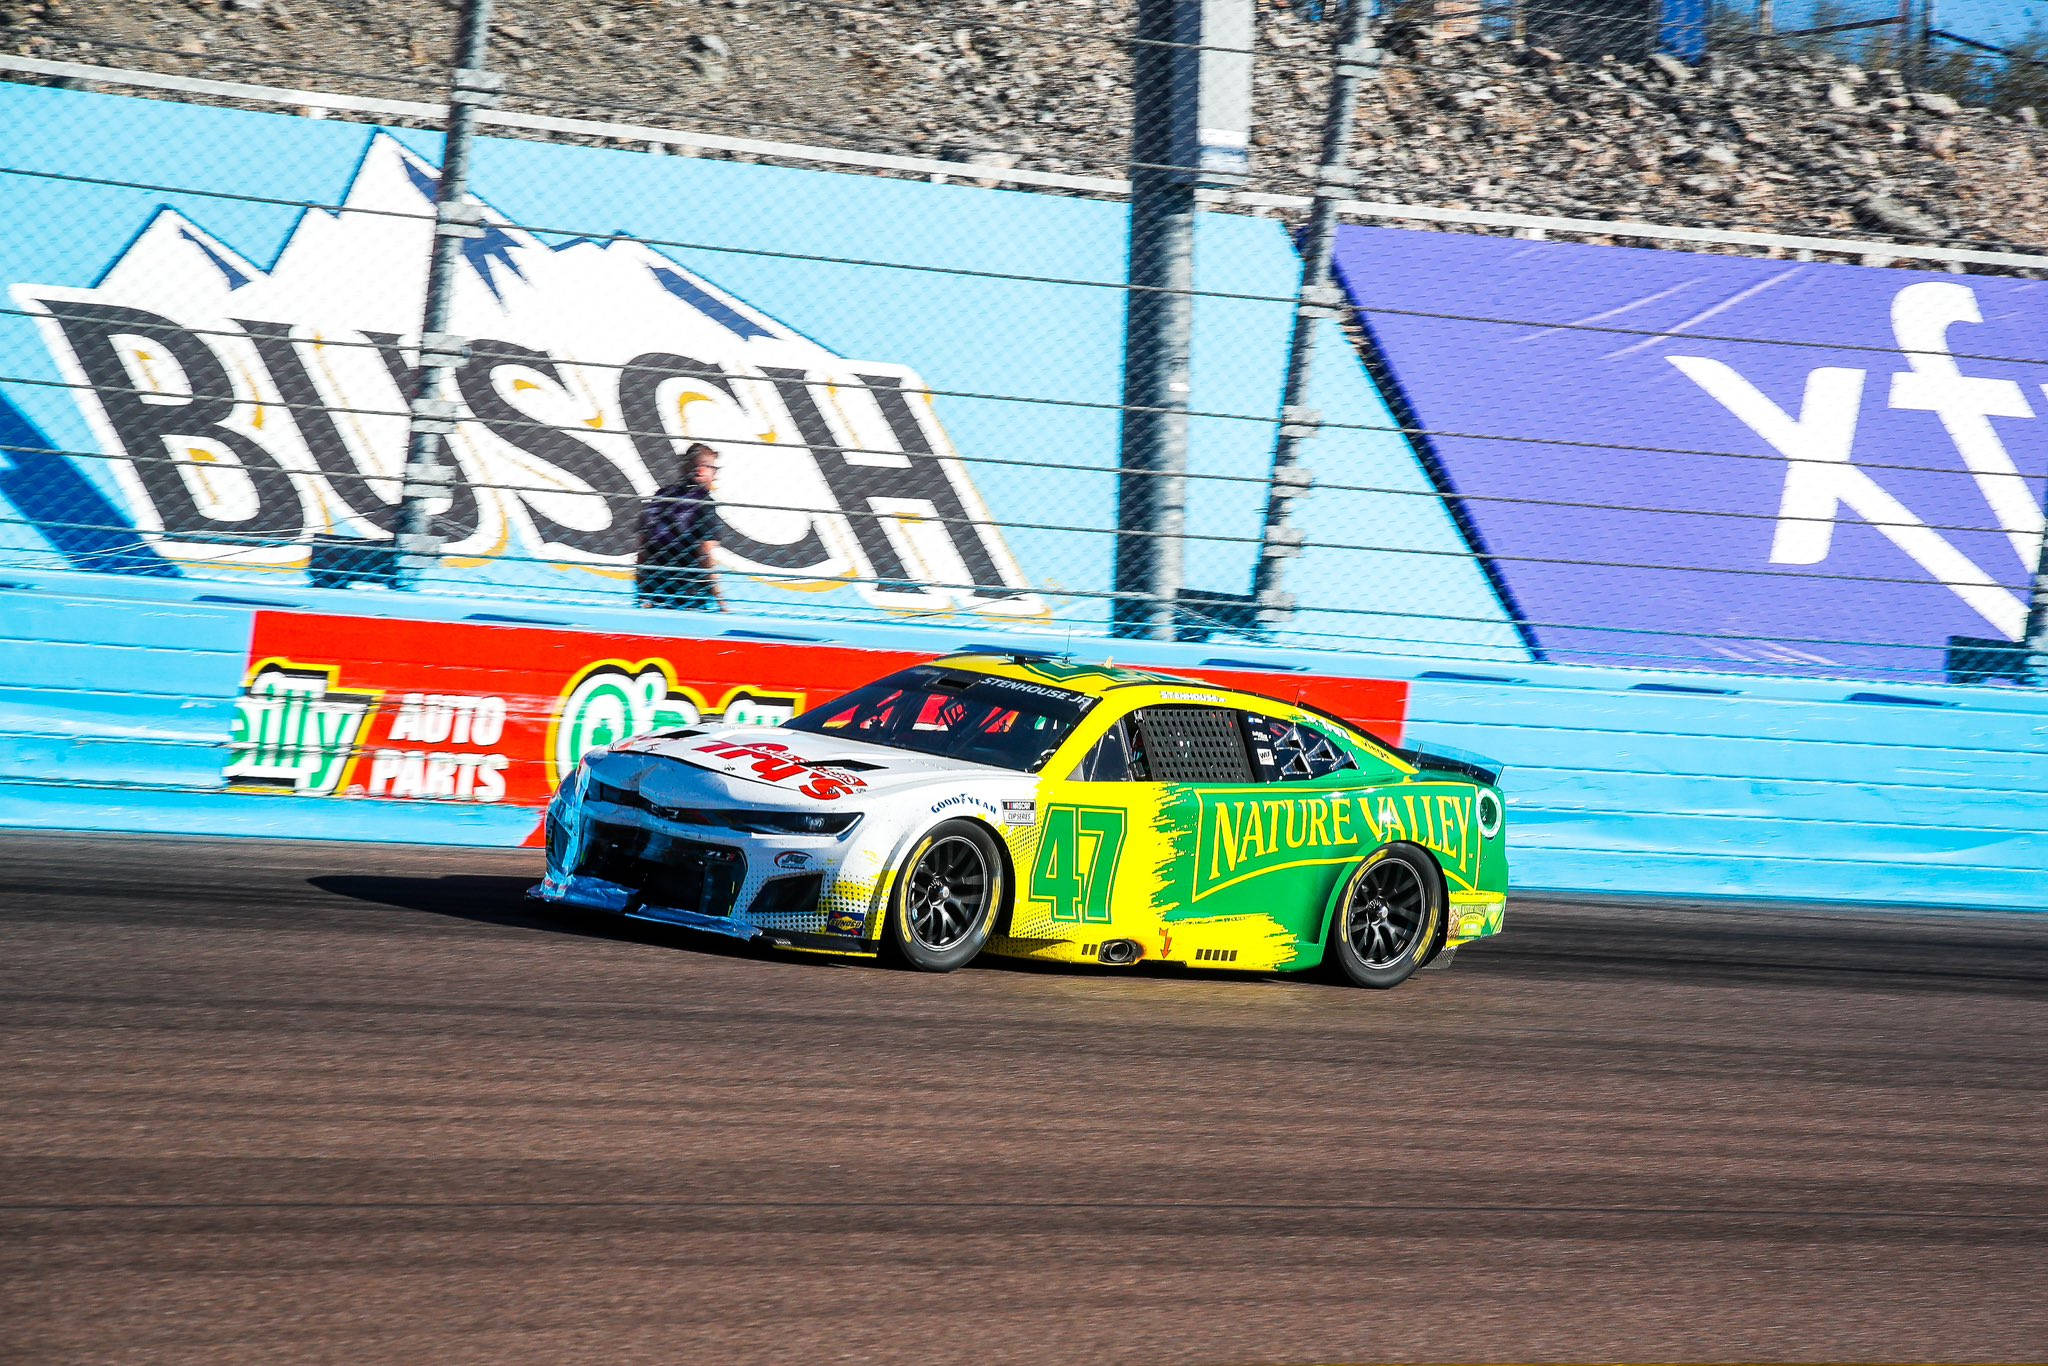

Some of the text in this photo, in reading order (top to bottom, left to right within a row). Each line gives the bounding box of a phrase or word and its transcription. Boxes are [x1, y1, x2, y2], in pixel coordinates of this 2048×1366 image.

[31, 298, 1028, 601] BUSCH
[1665, 281, 2048, 643] xf
[980, 676, 1071, 701] STENHOUSE
[387, 692, 506, 746] AUTO
[368, 748, 510, 802] PARTS
[930, 792, 997, 815] GOODYEAR
[1028, 802, 1128, 925] 47
[1208, 795, 1474, 881] NATURE VALLEY
[829, 919, 863, 928] SUNOCO
